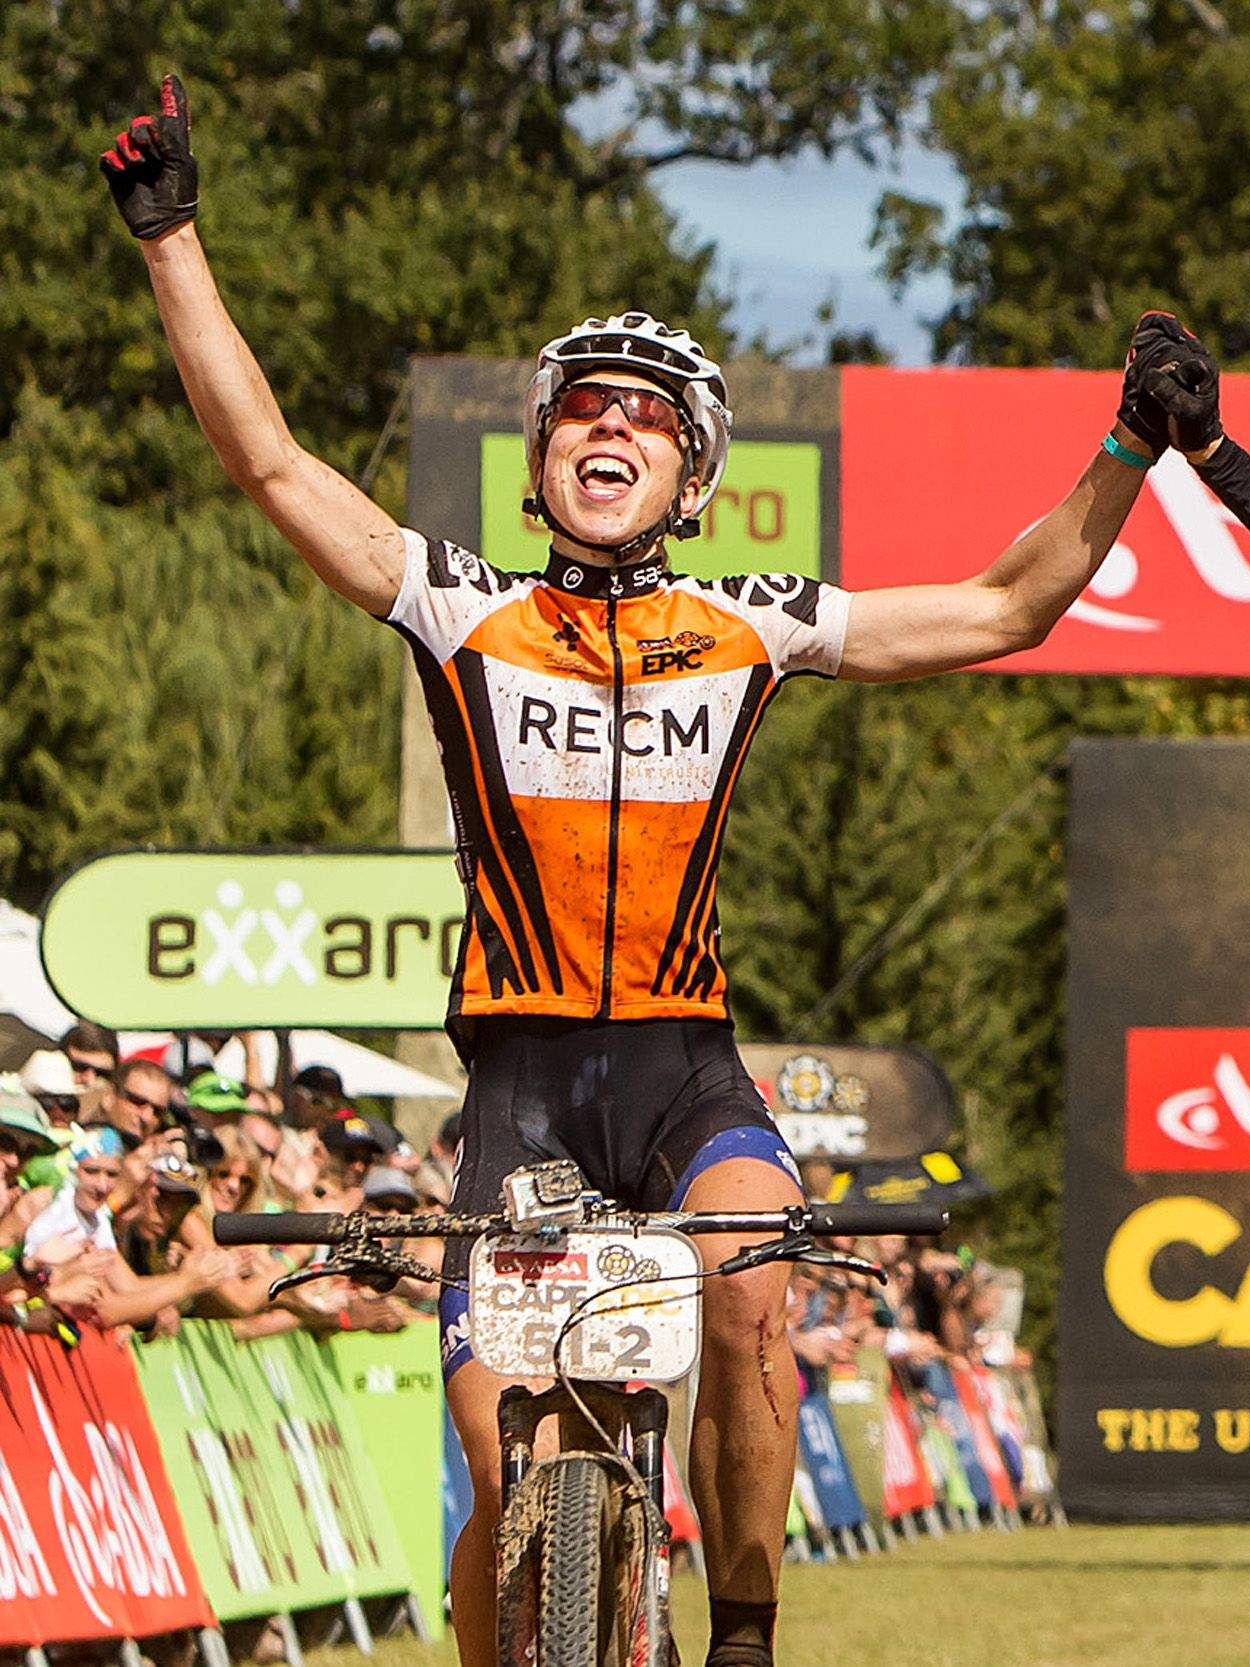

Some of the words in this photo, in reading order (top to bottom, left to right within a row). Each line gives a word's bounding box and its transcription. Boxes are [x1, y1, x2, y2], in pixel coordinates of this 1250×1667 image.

[641, 648, 704, 676] EPIC
[518, 695, 710, 757] RECM
[1097, 1408, 1200, 1453] THE
